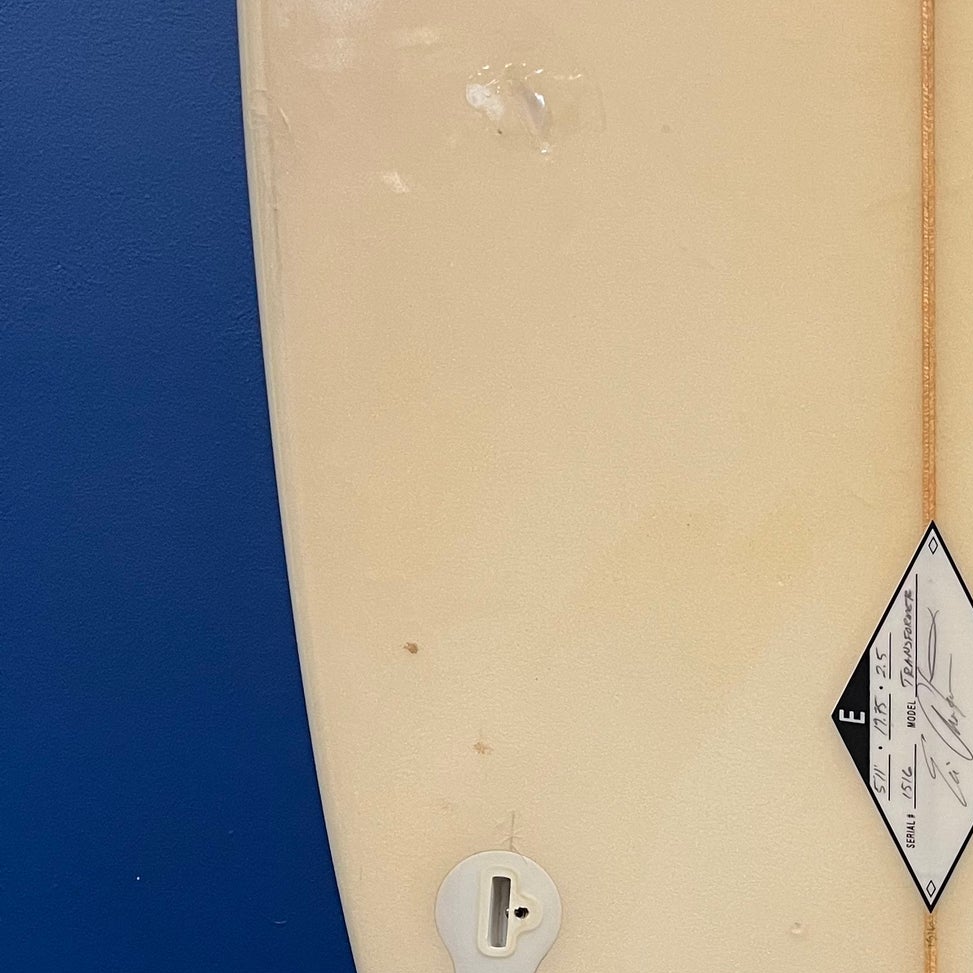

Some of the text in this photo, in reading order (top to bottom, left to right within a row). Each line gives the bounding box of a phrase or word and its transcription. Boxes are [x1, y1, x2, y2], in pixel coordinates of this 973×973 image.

[876, 648, 886, 678] 2.5
[838, 709, 866, 724] E
[907, 700, 916, 728] MODEL
[901, 767, 913, 799] 1516
[906, 821, 915, 848] SERIAL
